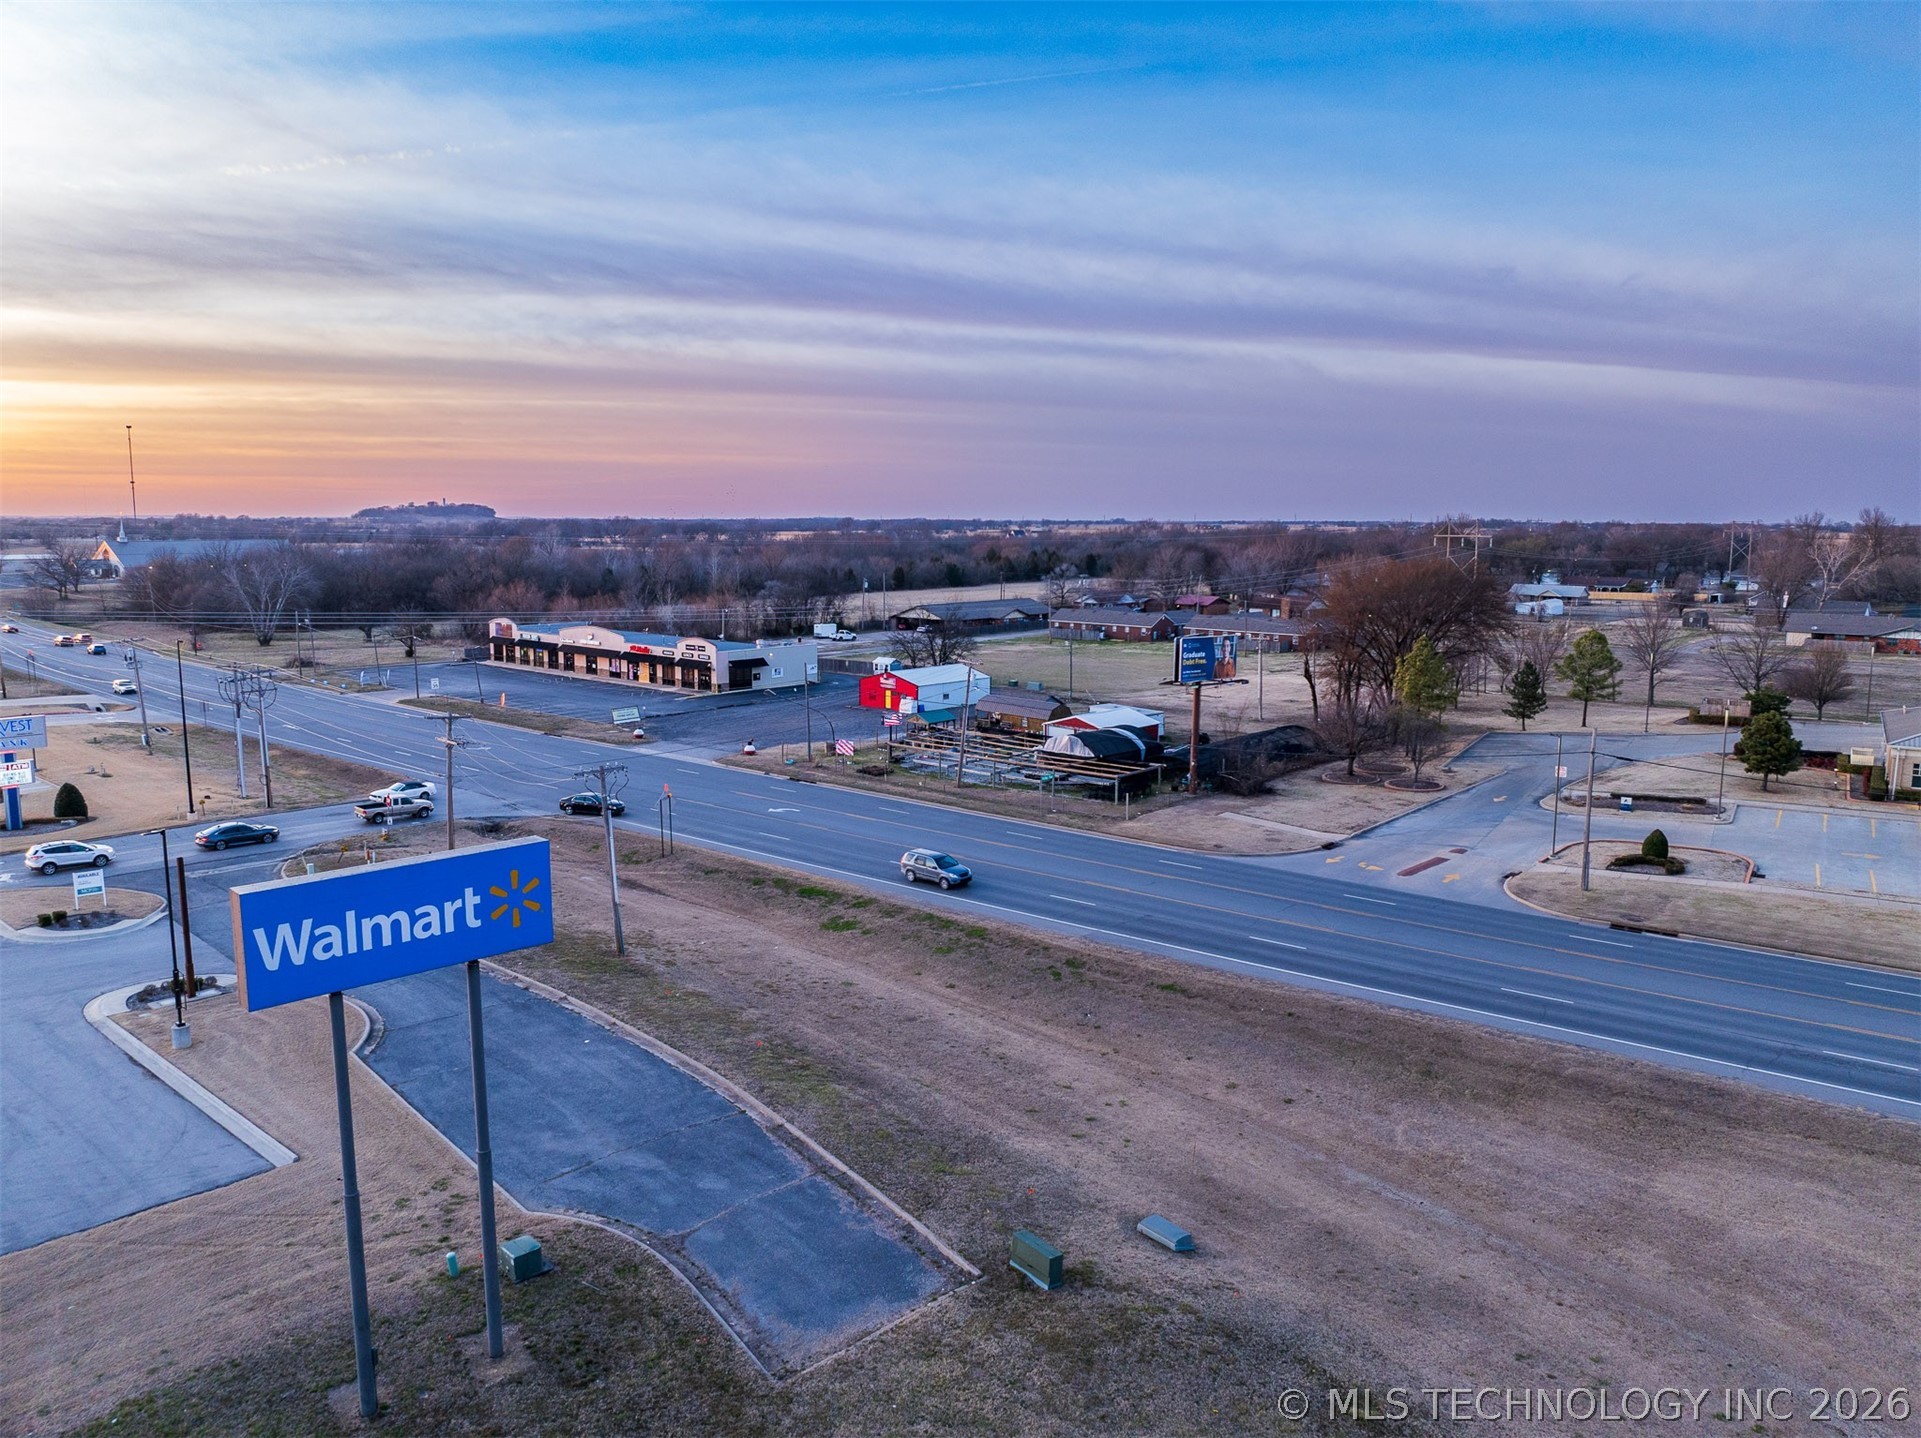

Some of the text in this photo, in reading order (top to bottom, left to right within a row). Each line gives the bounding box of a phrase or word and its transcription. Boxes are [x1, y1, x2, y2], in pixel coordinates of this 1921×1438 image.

[0, 719, 32, 733] VEST
[12, 762, 28, 770] ATM
[252, 887, 482, 972] Walmart
